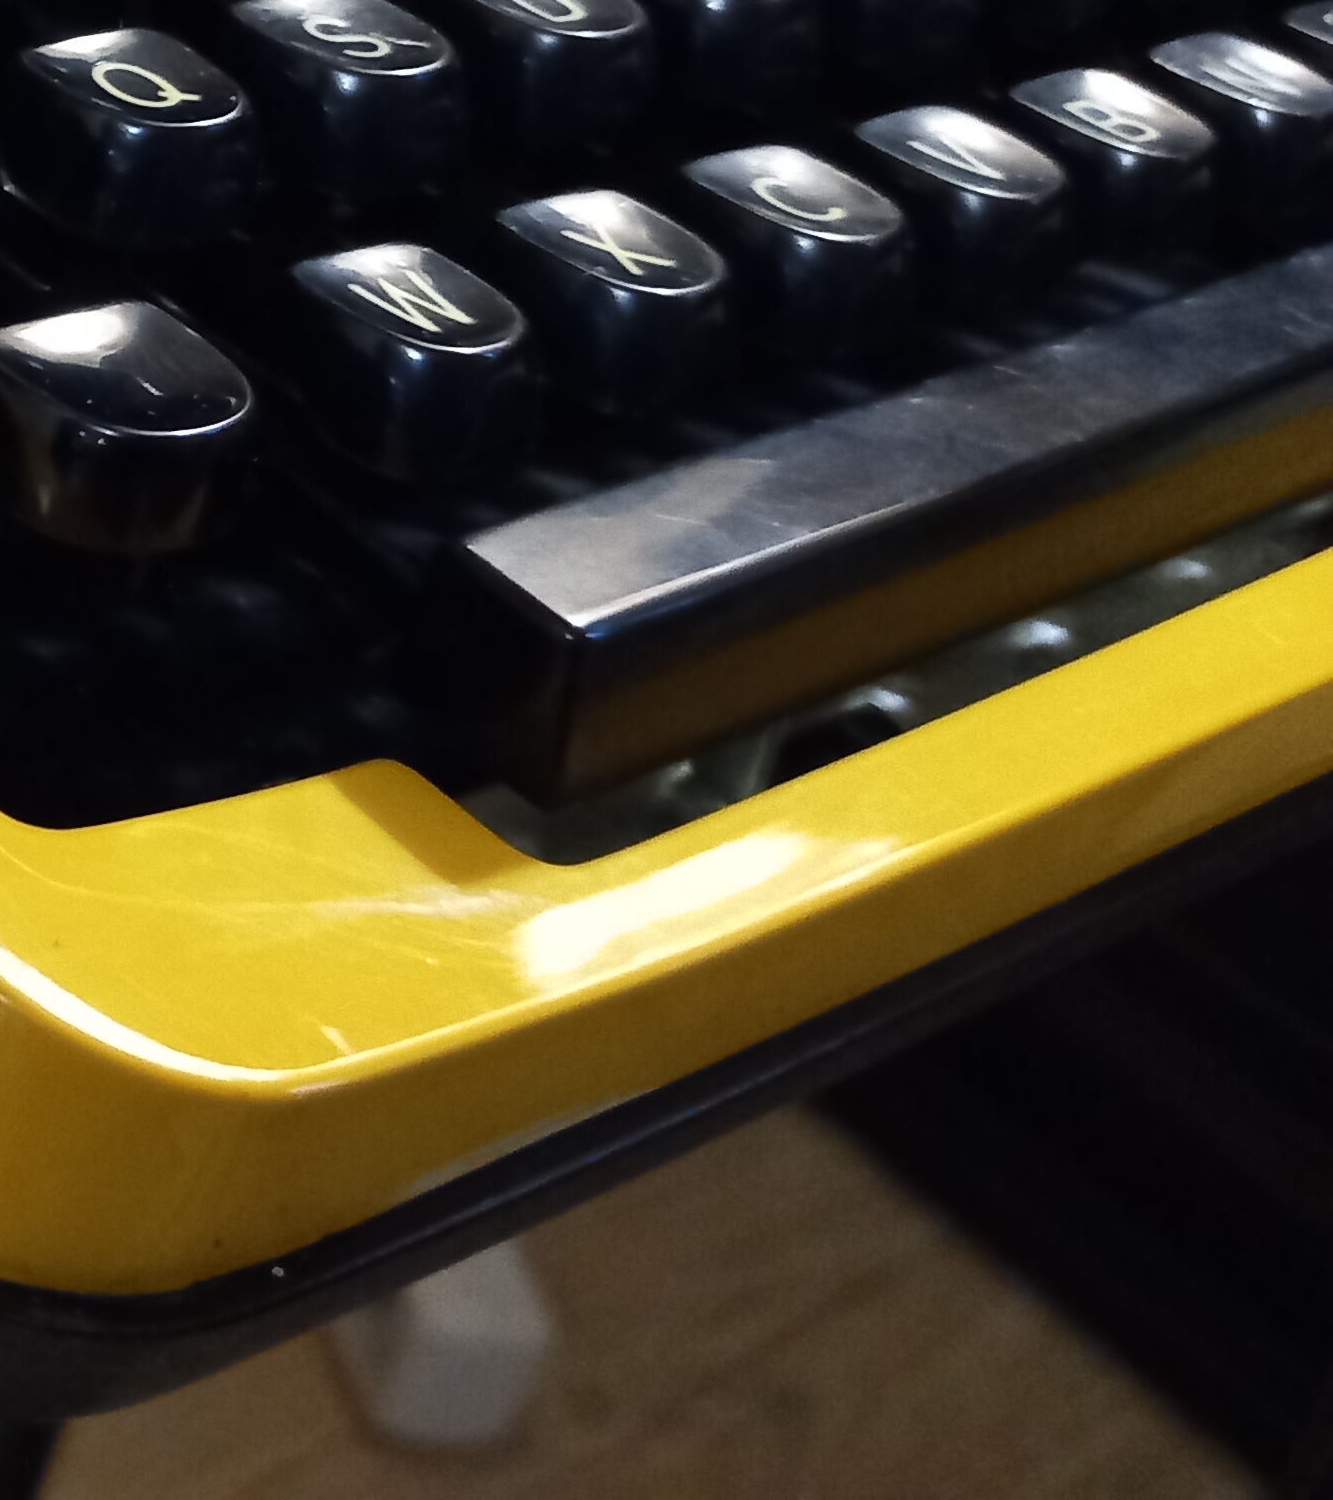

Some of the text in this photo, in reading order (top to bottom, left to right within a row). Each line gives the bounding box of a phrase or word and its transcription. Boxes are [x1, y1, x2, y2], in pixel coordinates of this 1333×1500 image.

[302, 16, 391, 59] S
[91, 61, 202, 108] Q
[1062, 100, 1162, 143] B
[907, 137, 1007, 181] V
[750, 176, 846, 221] C
[560, 220, 678, 276] X
[347, 269, 478, 333] W
